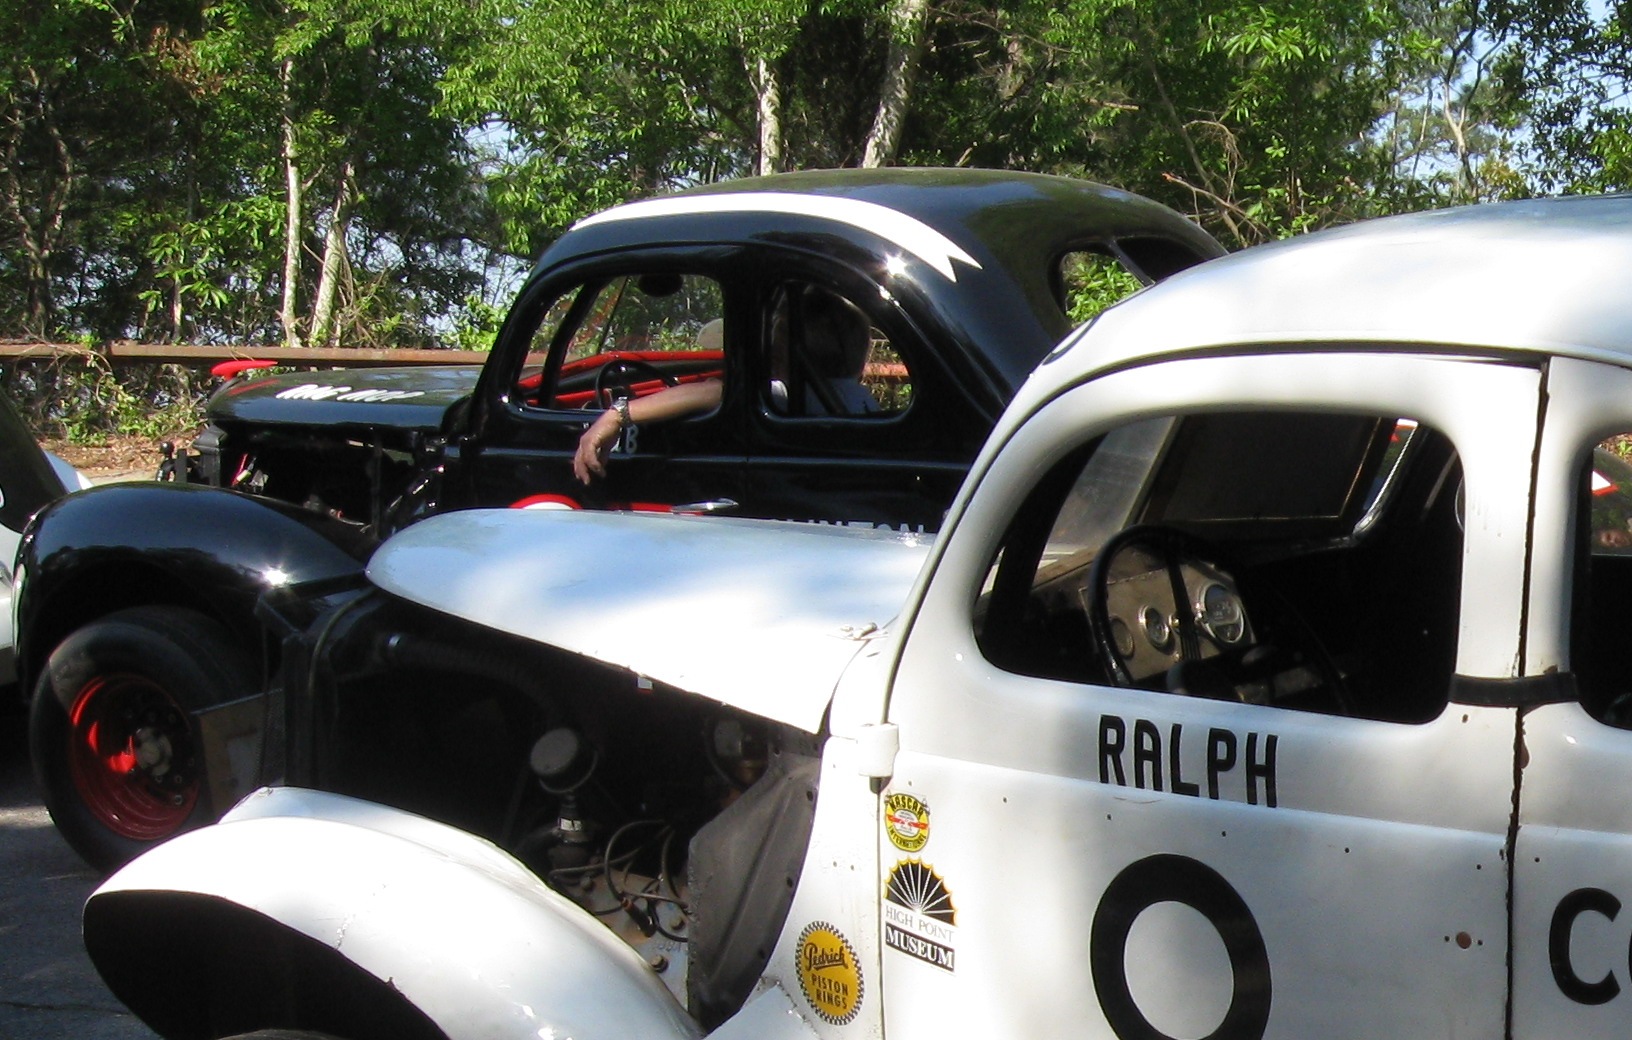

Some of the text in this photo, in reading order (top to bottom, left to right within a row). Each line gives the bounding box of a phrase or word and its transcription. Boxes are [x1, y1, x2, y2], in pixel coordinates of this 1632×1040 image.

[1098, 714, 1279, 809] RALPH
[889, 795, 924, 821] NASCAR
[885, 904, 955, 942] HIGH POINT
[804, 942, 849, 971] Pedrick
[885, 925, 954, 969] MUSEUM
[811, 973, 849, 996] PISTON
[816, 988, 848, 1009] RINGS
